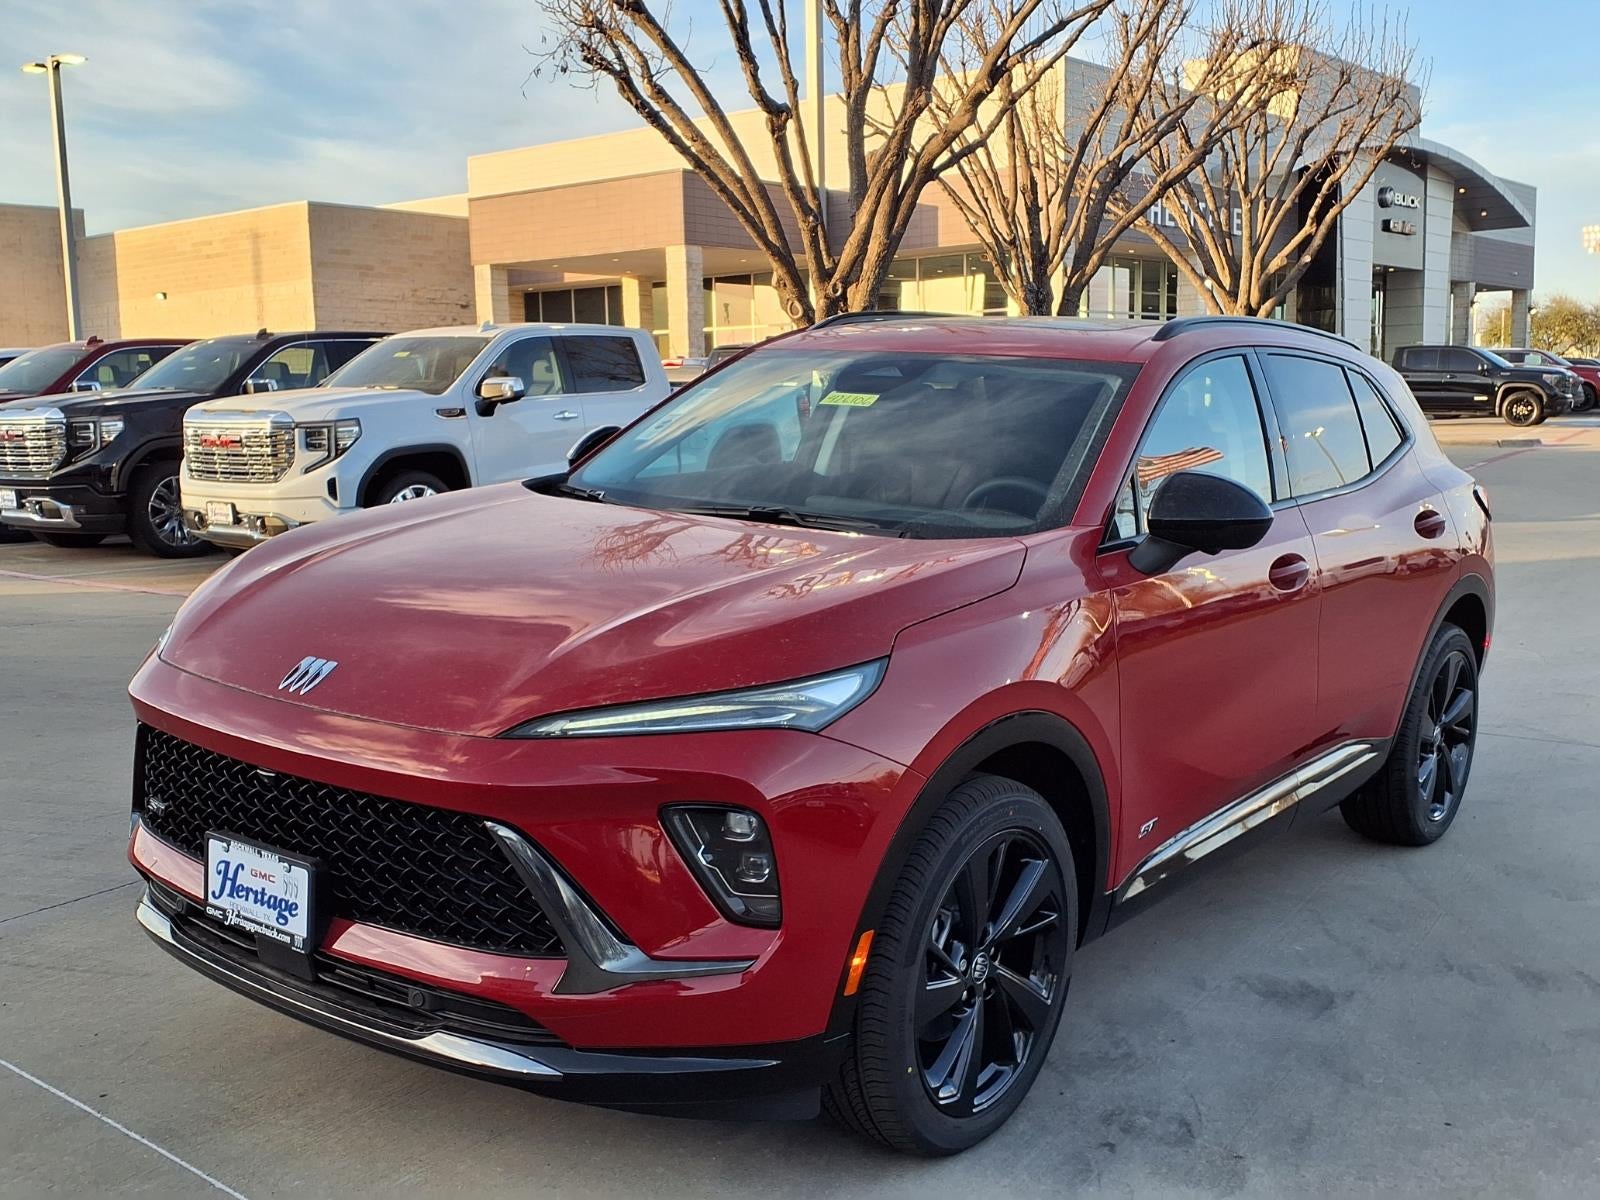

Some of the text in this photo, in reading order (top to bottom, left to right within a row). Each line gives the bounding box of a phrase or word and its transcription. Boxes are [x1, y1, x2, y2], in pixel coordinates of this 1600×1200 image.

[1394, 192, 1421, 208] BUICK
[250, 868, 276, 884] GMC
[211, 859, 299, 926] Heritage
[206, 906, 223, 919] GMC
